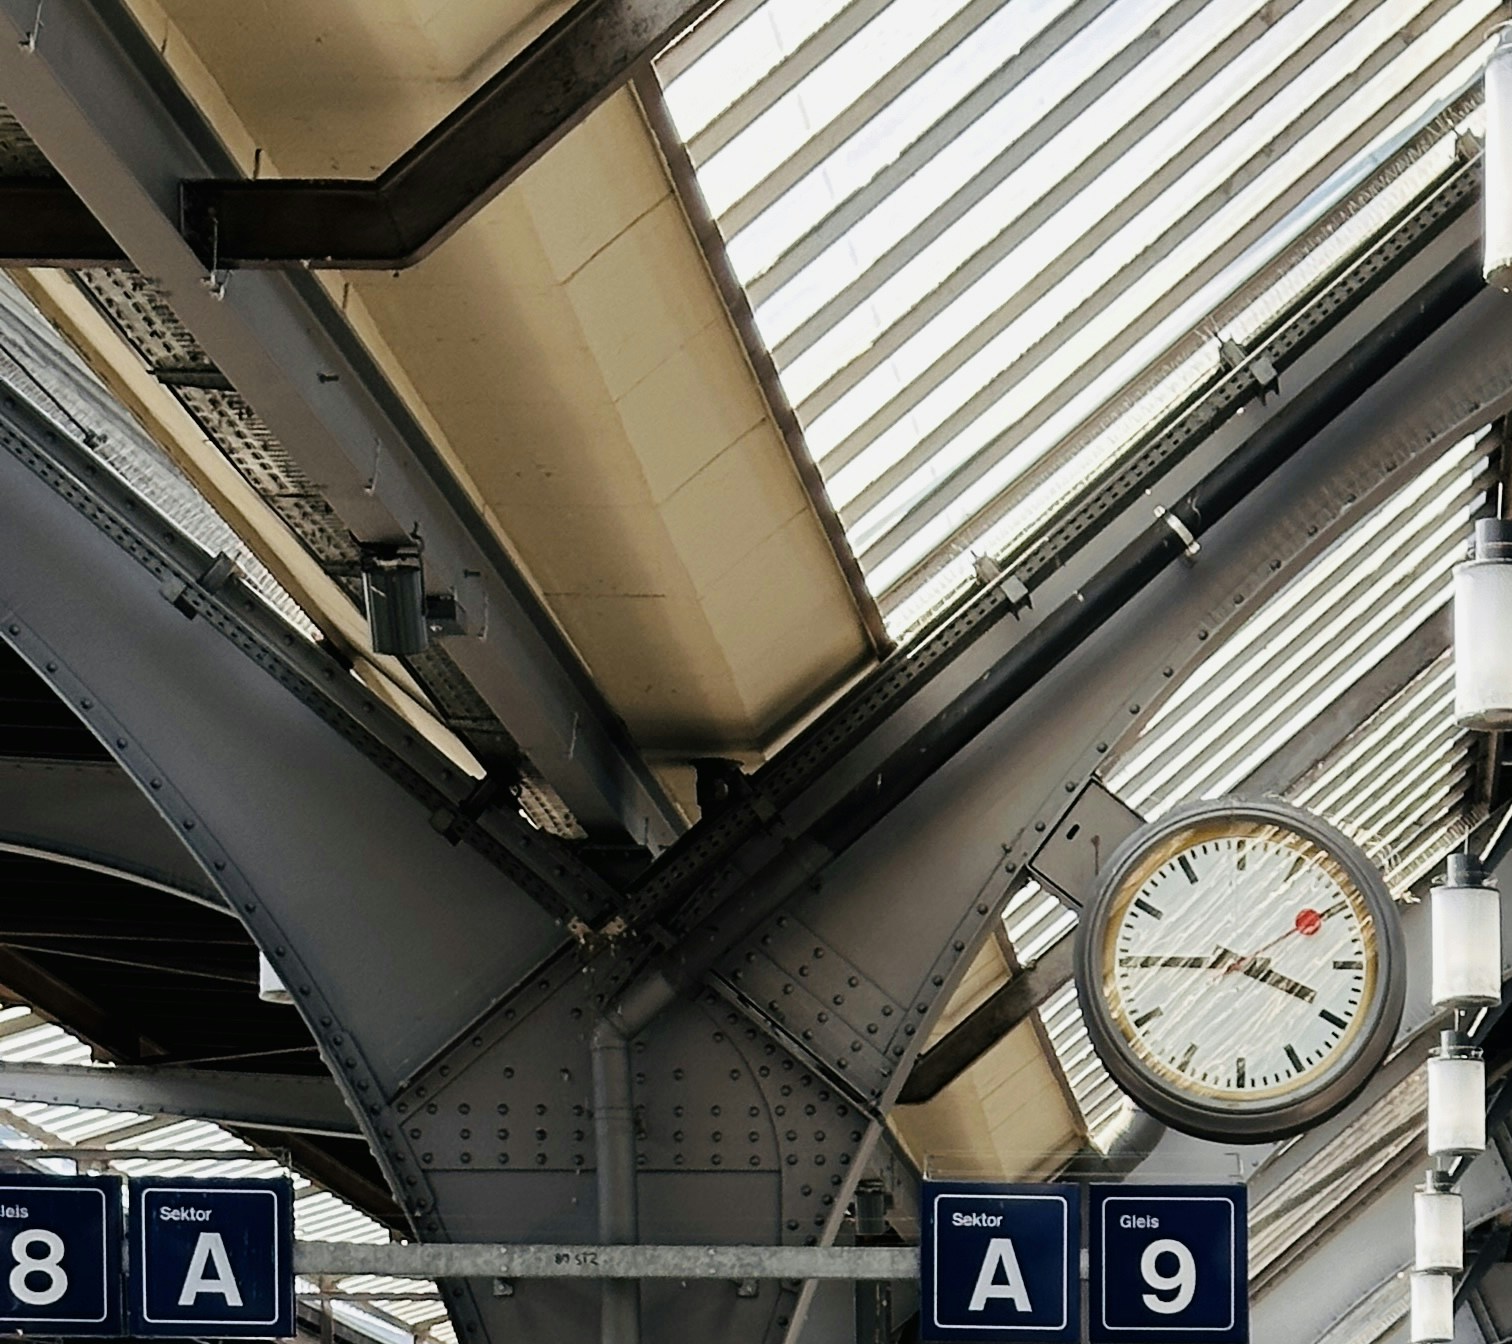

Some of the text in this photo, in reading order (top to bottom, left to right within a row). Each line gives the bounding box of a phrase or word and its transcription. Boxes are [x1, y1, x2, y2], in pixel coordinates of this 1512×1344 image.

[0, 1204, 29, 1218] leis
[159, 1206, 212, 1221] Sektor
[951, 1212, 1003, 1227] Sektor
[1119, 1214, 1159, 1229] Gleis
[9, 1229, 68, 1305] 8
[177, 1232, 243, 1307] A
[967, 1238, 1033, 1313] A
[1140, 1238, 1196, 1314] 9
